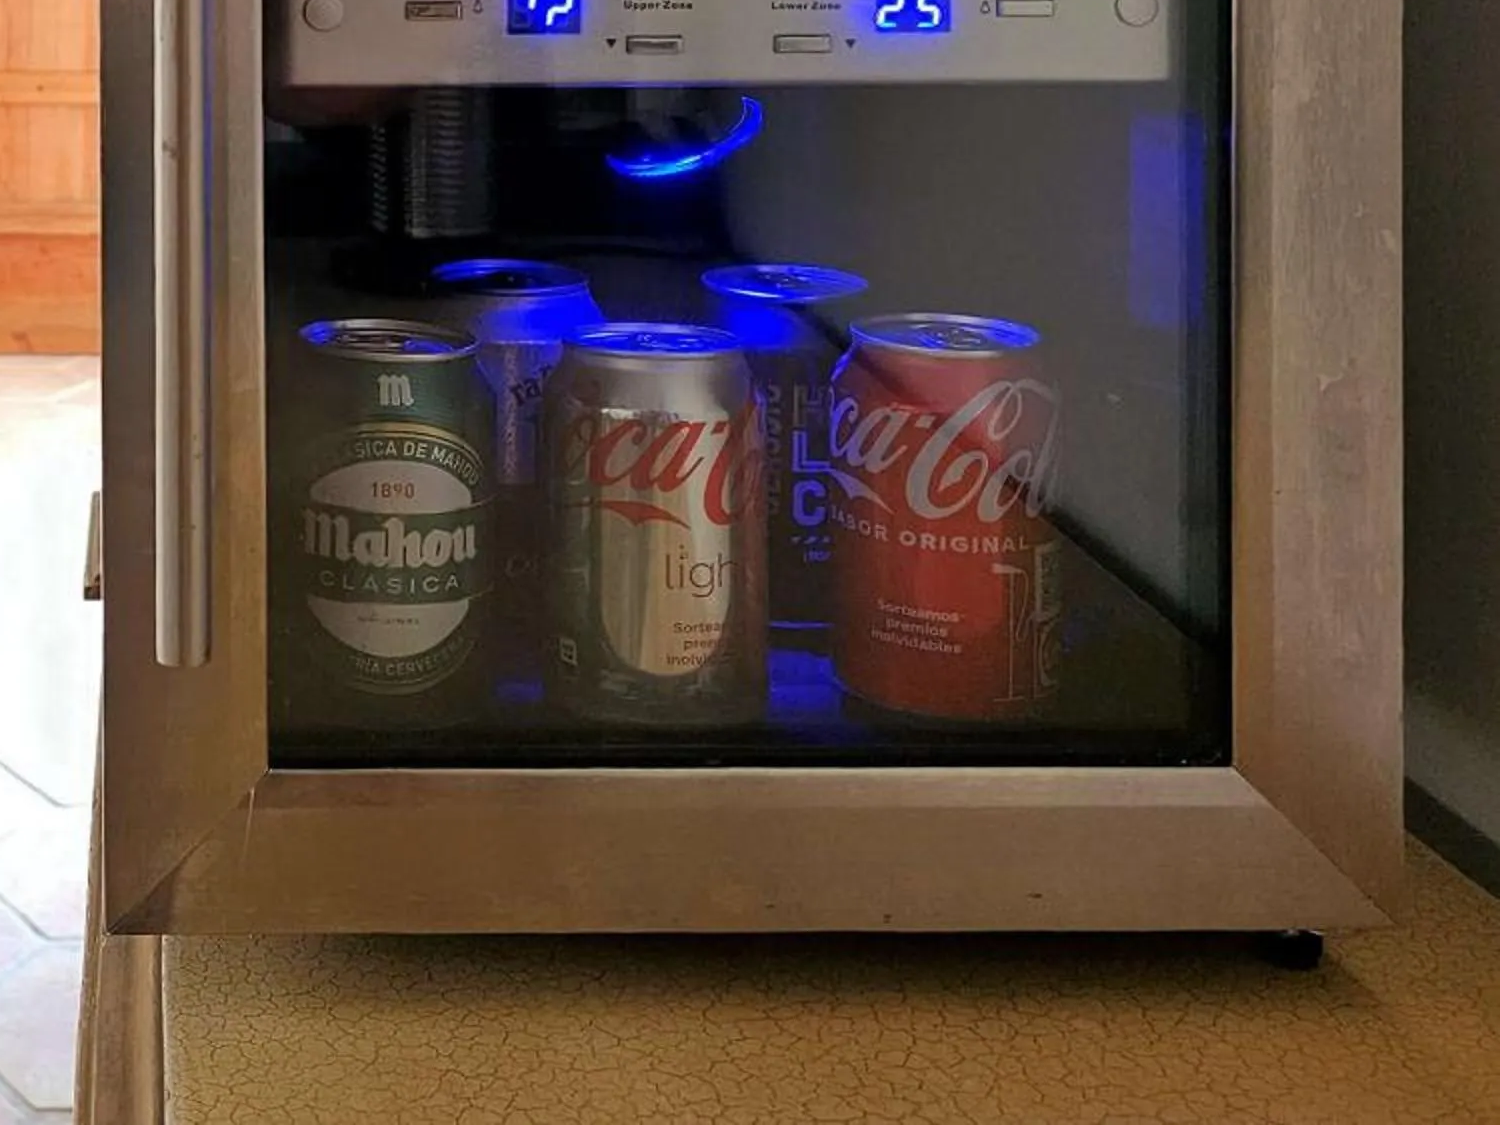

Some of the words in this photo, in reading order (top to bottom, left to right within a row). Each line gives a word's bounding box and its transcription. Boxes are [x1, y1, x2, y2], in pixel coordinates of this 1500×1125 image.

[622, 0, 660, 11] Upper
[663, 0, 694, 10] Zone
[771, 1, 808, 11] Lower
[811, 1, 842, 11] Zone
[403, 442, 428, 458] DE
[431, 446, 480, 487] MAHOU
[371, 482, 416, 499] 1890
[899, 530, 1030, 554] ORIGINAL
[320, 570, 459, 594] CLASICA
[665, 544, 740, 598] ligh
[877, 598, 960, 623] Sorteamos
[885, 616, 949, 638] premios
[870, 628, 963, 655] inolvidables
